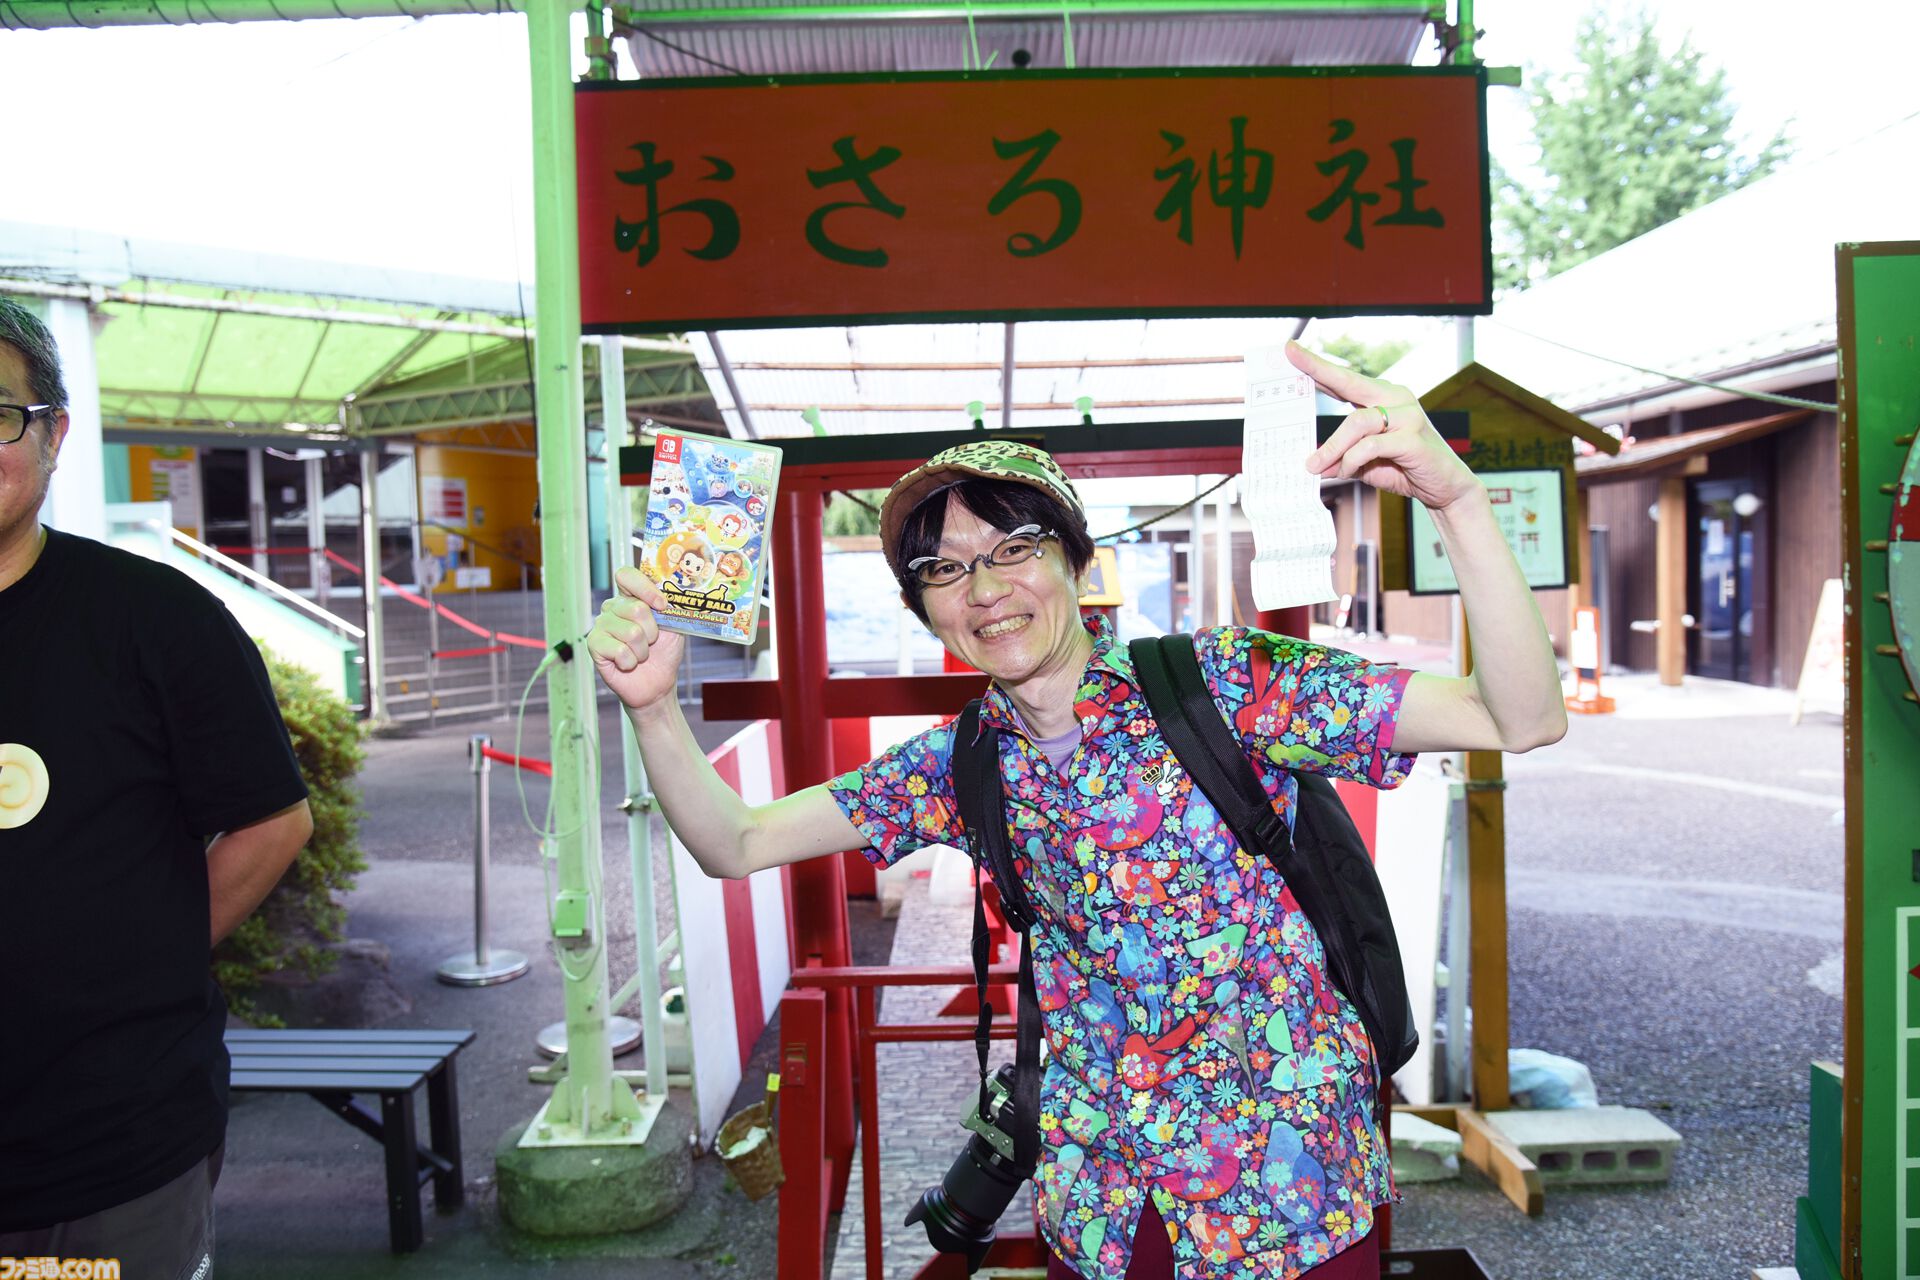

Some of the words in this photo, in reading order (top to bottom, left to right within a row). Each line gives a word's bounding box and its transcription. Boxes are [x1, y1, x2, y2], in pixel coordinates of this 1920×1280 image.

[613, 116, 1445, 267] おさる神社
[706, 600, 733, 612] BALL
[693, 611, 724, 622] RUMBLE
